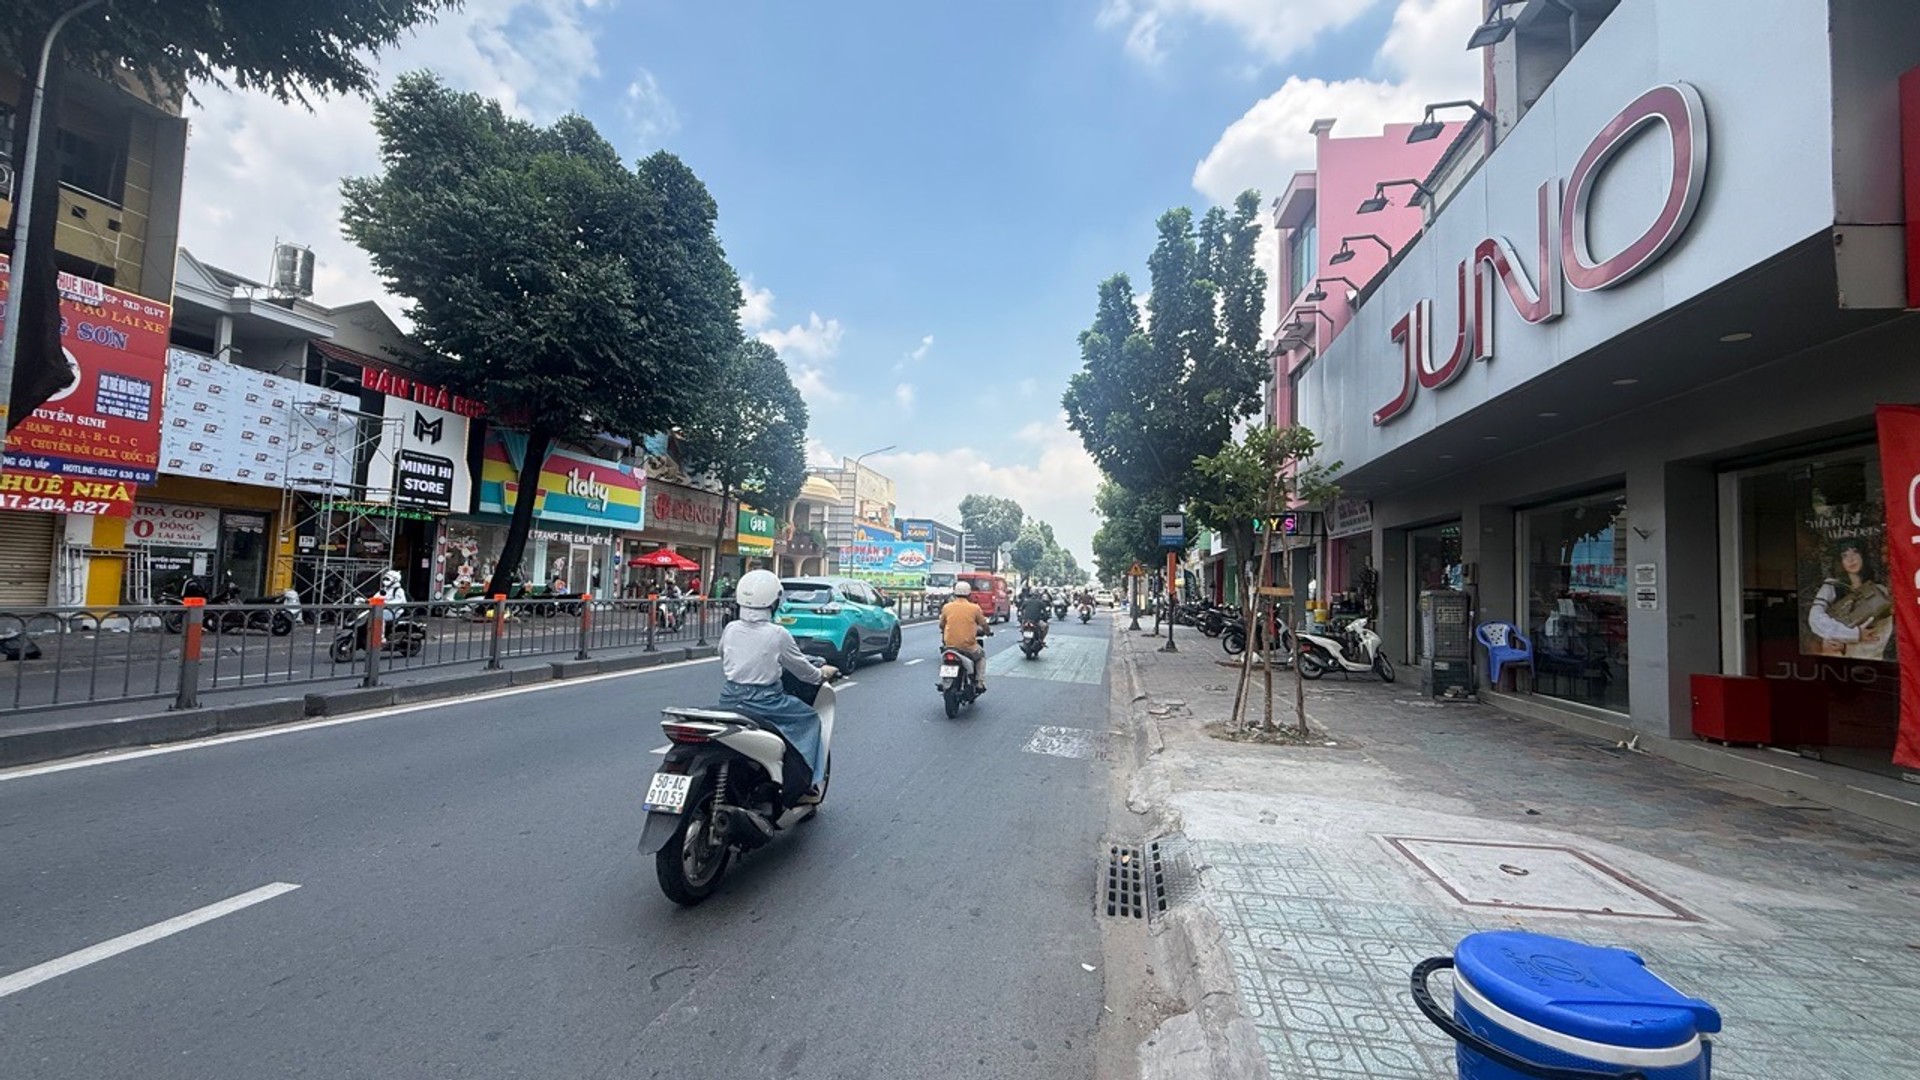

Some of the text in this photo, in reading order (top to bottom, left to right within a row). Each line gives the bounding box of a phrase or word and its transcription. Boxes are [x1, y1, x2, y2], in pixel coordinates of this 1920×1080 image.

[1373, 80, 1709, 426] JUNO
[361, 366, 410, 398] BÁN
[76, 415, 107, 429] SINH
[130, 437, 138, 447] C
[400, 460, 436, 477] MINH
[70, 481, 130, 502] NHÀ
[403, 477, 445, 495] STORE
[1765, 662, 1878, 683] JUNO
[655, 775, 687, 790] 50-AC
